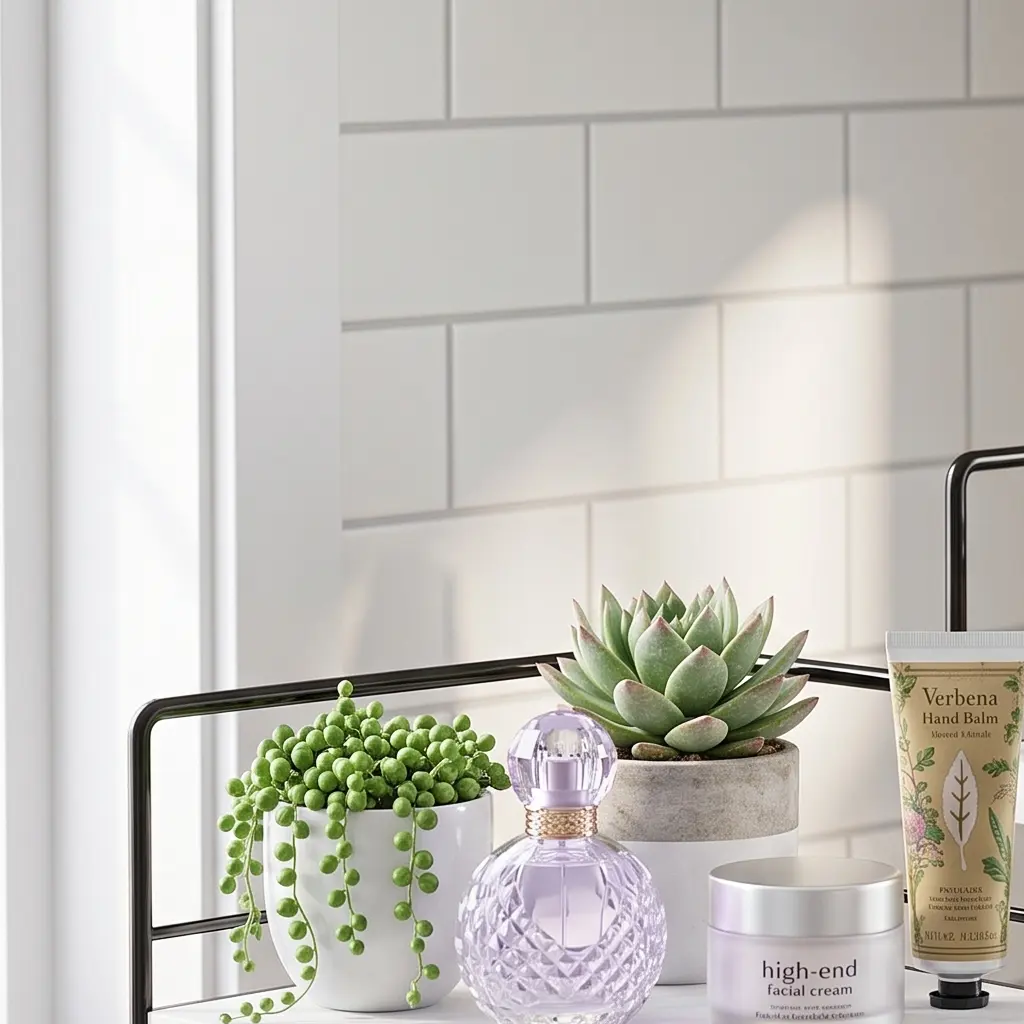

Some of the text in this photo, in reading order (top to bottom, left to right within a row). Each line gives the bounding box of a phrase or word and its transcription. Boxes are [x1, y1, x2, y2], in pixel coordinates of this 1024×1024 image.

[922, 687, 998, 706] Verbena
[922, 712, 999, 724] Hand Balm
[762, 959, 858, 985] high-end
[767, 983, 853, 997] facial cream
